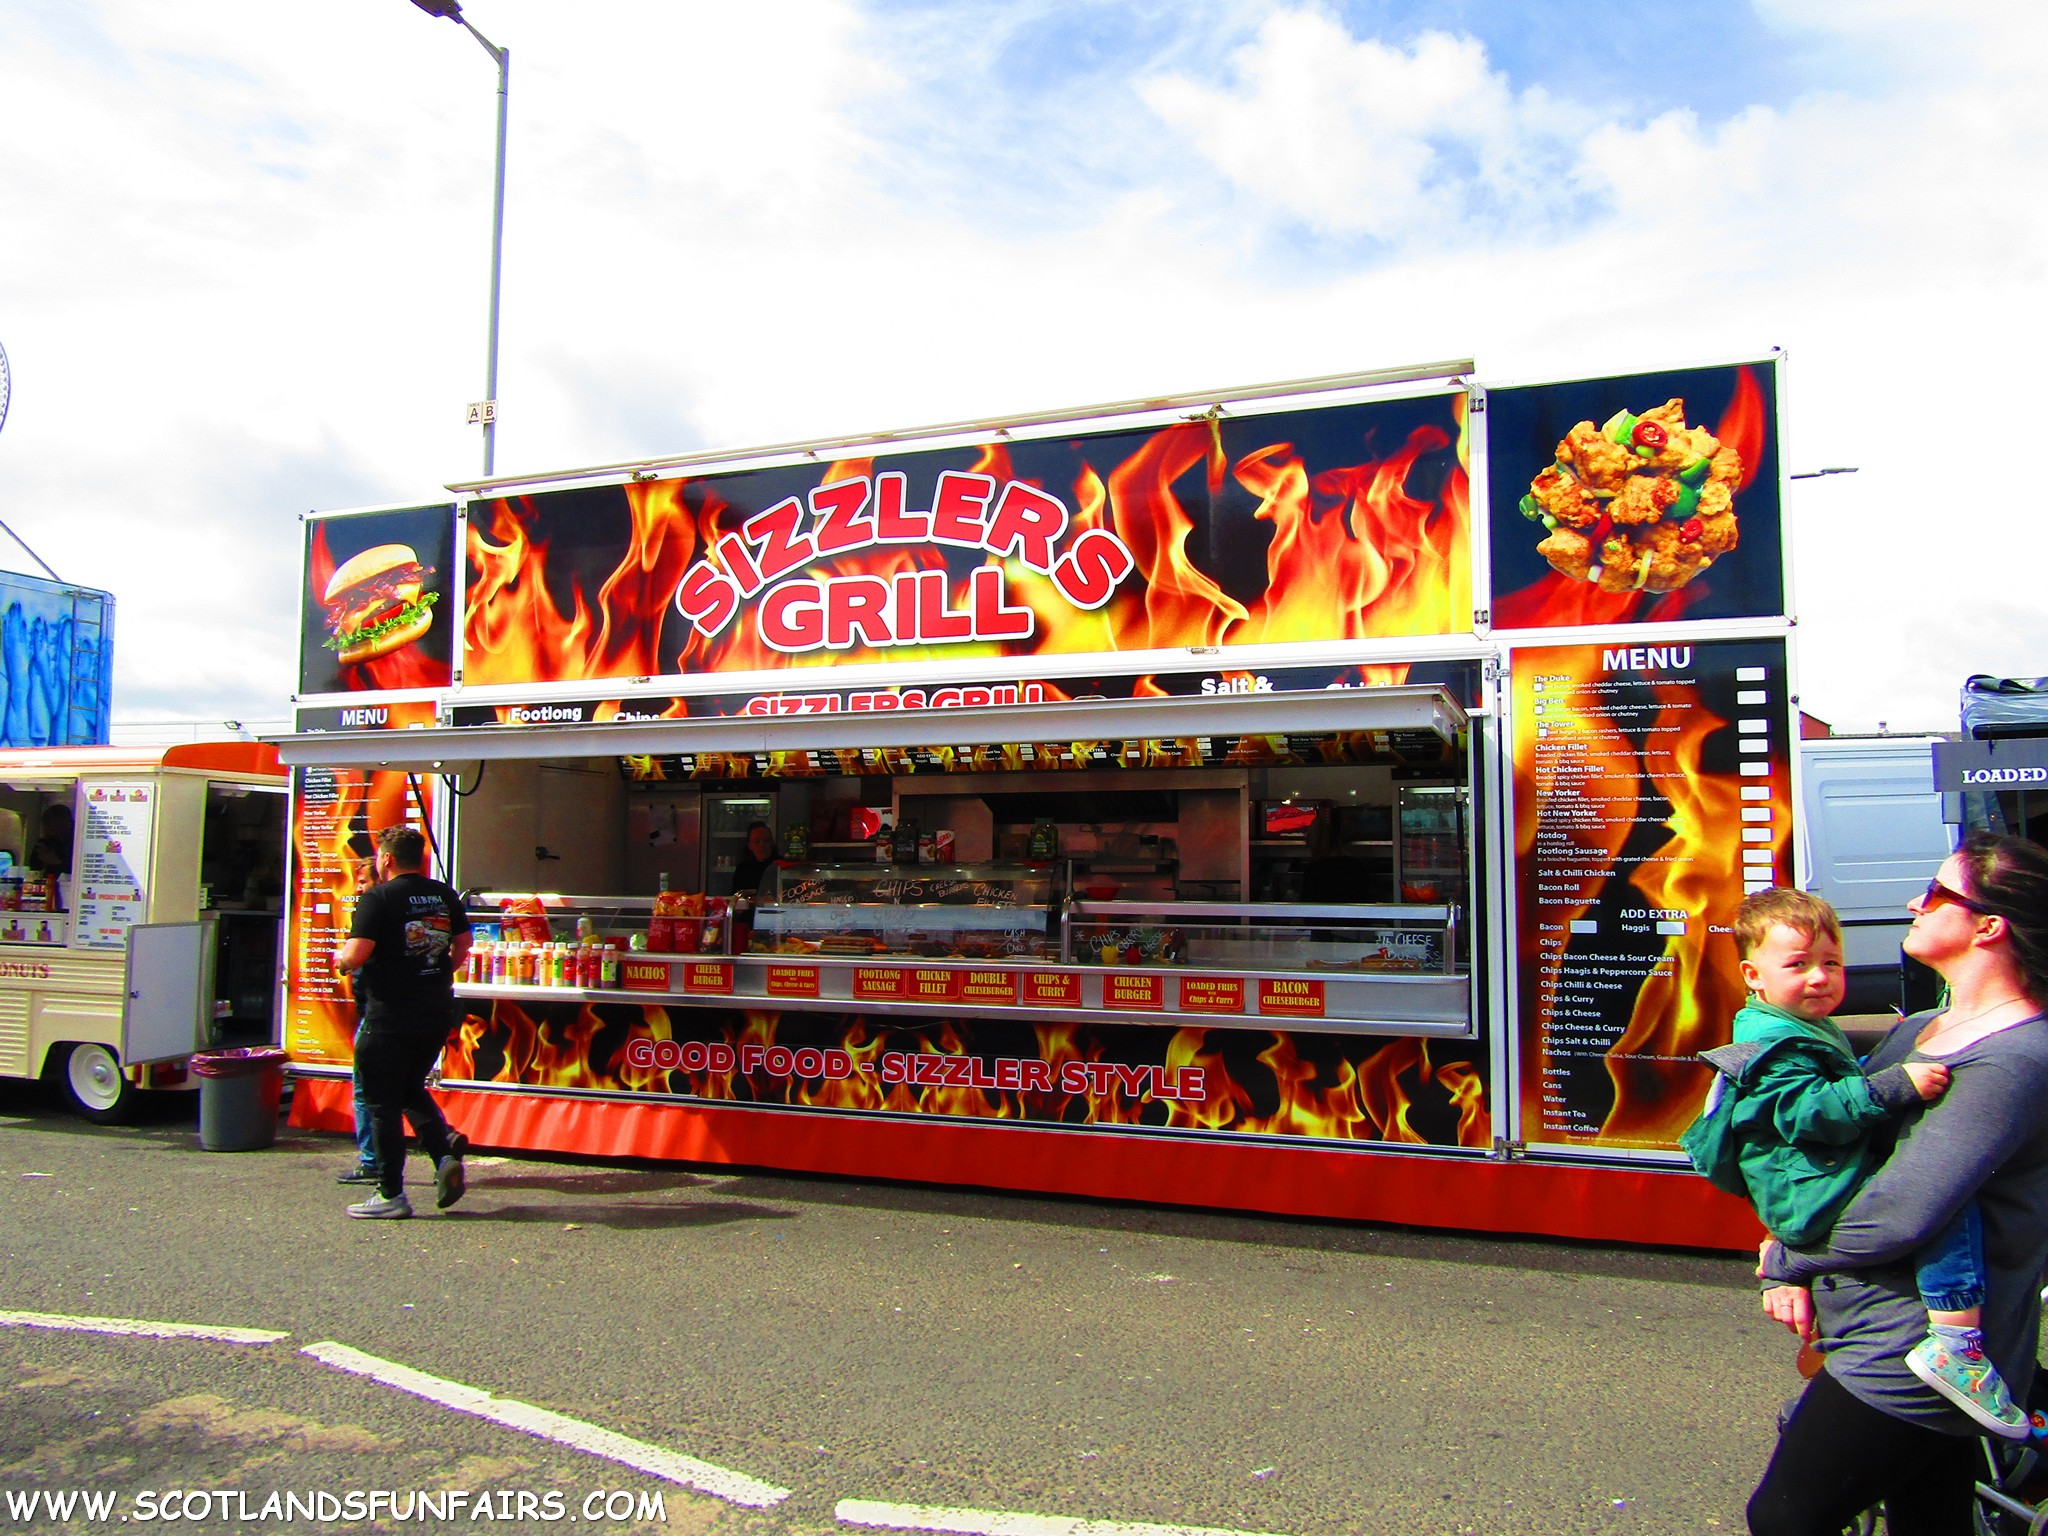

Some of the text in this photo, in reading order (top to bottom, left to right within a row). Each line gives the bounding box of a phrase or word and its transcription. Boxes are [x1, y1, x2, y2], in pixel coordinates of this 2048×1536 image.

[470, 408, 478, 418] A
[486, 406, 494, 416] B
[676, 470, 1134, 637] SIZZLERS
[758, 566, 1034, 652] GRILL
[1602, 646, 1691, 671] MENU
[1201, 676, 1274, 695] Salt &
[341, 708, 388, 727] MENU
[510, 706, 582, 722] Footlong
[1536, 766, 1550, 774] Hot
[1962, 768, 2047, 784] LOADED
[1537, 832, 1567, 840] Hotdog
[1538, 848, 1608, 856] Footlong Sausage
[872, 879, 924, 898] CHIPS
[1564, 898, 1600, 906] Baguette
[1620, 909, 1688, 918] ADD EXTRA
[1622, 924, 1650, 932] Haggis
[1540, 939, 1562, 947] Chips
[1540, 952, 1562, 961] Chips
[626, 966, 666, 980] NACHOS
[694, 964, 722, 974] CHEESE
[772, 969, 815, 978] LOADED FRIES
[858, 968, 900, 980] FOOTLONG
[1540, 966, 1562, 975] Chips
[1564, 967, 1591, 976] Haagis
[1600, 968, 1646, 977] Peppercorn
[693, 975, 723, 986] BURGER
[916, 970, 951, 982] CHICKEN
[970, 972, 1007, 984] DOUBLE
[1034, 974, 1070, 985] CHIPS &
[862, 980, 896, 992] SAUSAGE
[1114, 976, 1152, 988] CHICKEN
[1186, 982, 1238, 992] LOADED FRIES
[1540, 980, 1563, 989] Chips
[1564, 980, 1585, 988] Chilli
[1594, 982, 1623, 990] Cheese
[919, 982, 946, 994] FILLET
[964, 986, 1014, 996] CHEESEBURGER
[1037, 986, 1066, 998] CURRY
[1273, 981, 1309, 994] BACON
[1114, 989, 1152, 1000] BURGER
[1540, 994, 1563, 1003] Chips
[1572, 996, 1594, 1004] Curry
[1189, 996, 1234, 1005] Chips & Curry
[1262, 996, 1320, 1006] CHEESEBURGER
[1541, 1008, 1564, 1017] Chips
[1572, 1010, 1601, 1018] Cheese
[1542, 1022, 1564, 1031] Chips
[1564, 1023, 1594, 1031] Cheese
[1602, 1024, 1626, 1034] Curry
[1542, 1036, 1564, 1045] Chips
[1565, 1037, 1581, 1045] Salt
[1590, 1038, 1611, 1046] Chilli
[1542, 1048, 1571, 1056] Nachos
[627, 1038, 735, 1074] GOOD
[741, 1044, 852, 1080] FOOD
[882, 1054, 1053, 1093] SIZZLER
[1060, 1060, 1207, 1101] STYLE
[1542, 1068, 1571, 1076] Bottles
[1543, 1109, 1587, 1118] Instant Tea
[1544, 1123, 1599, 1132] Instant Coffee
